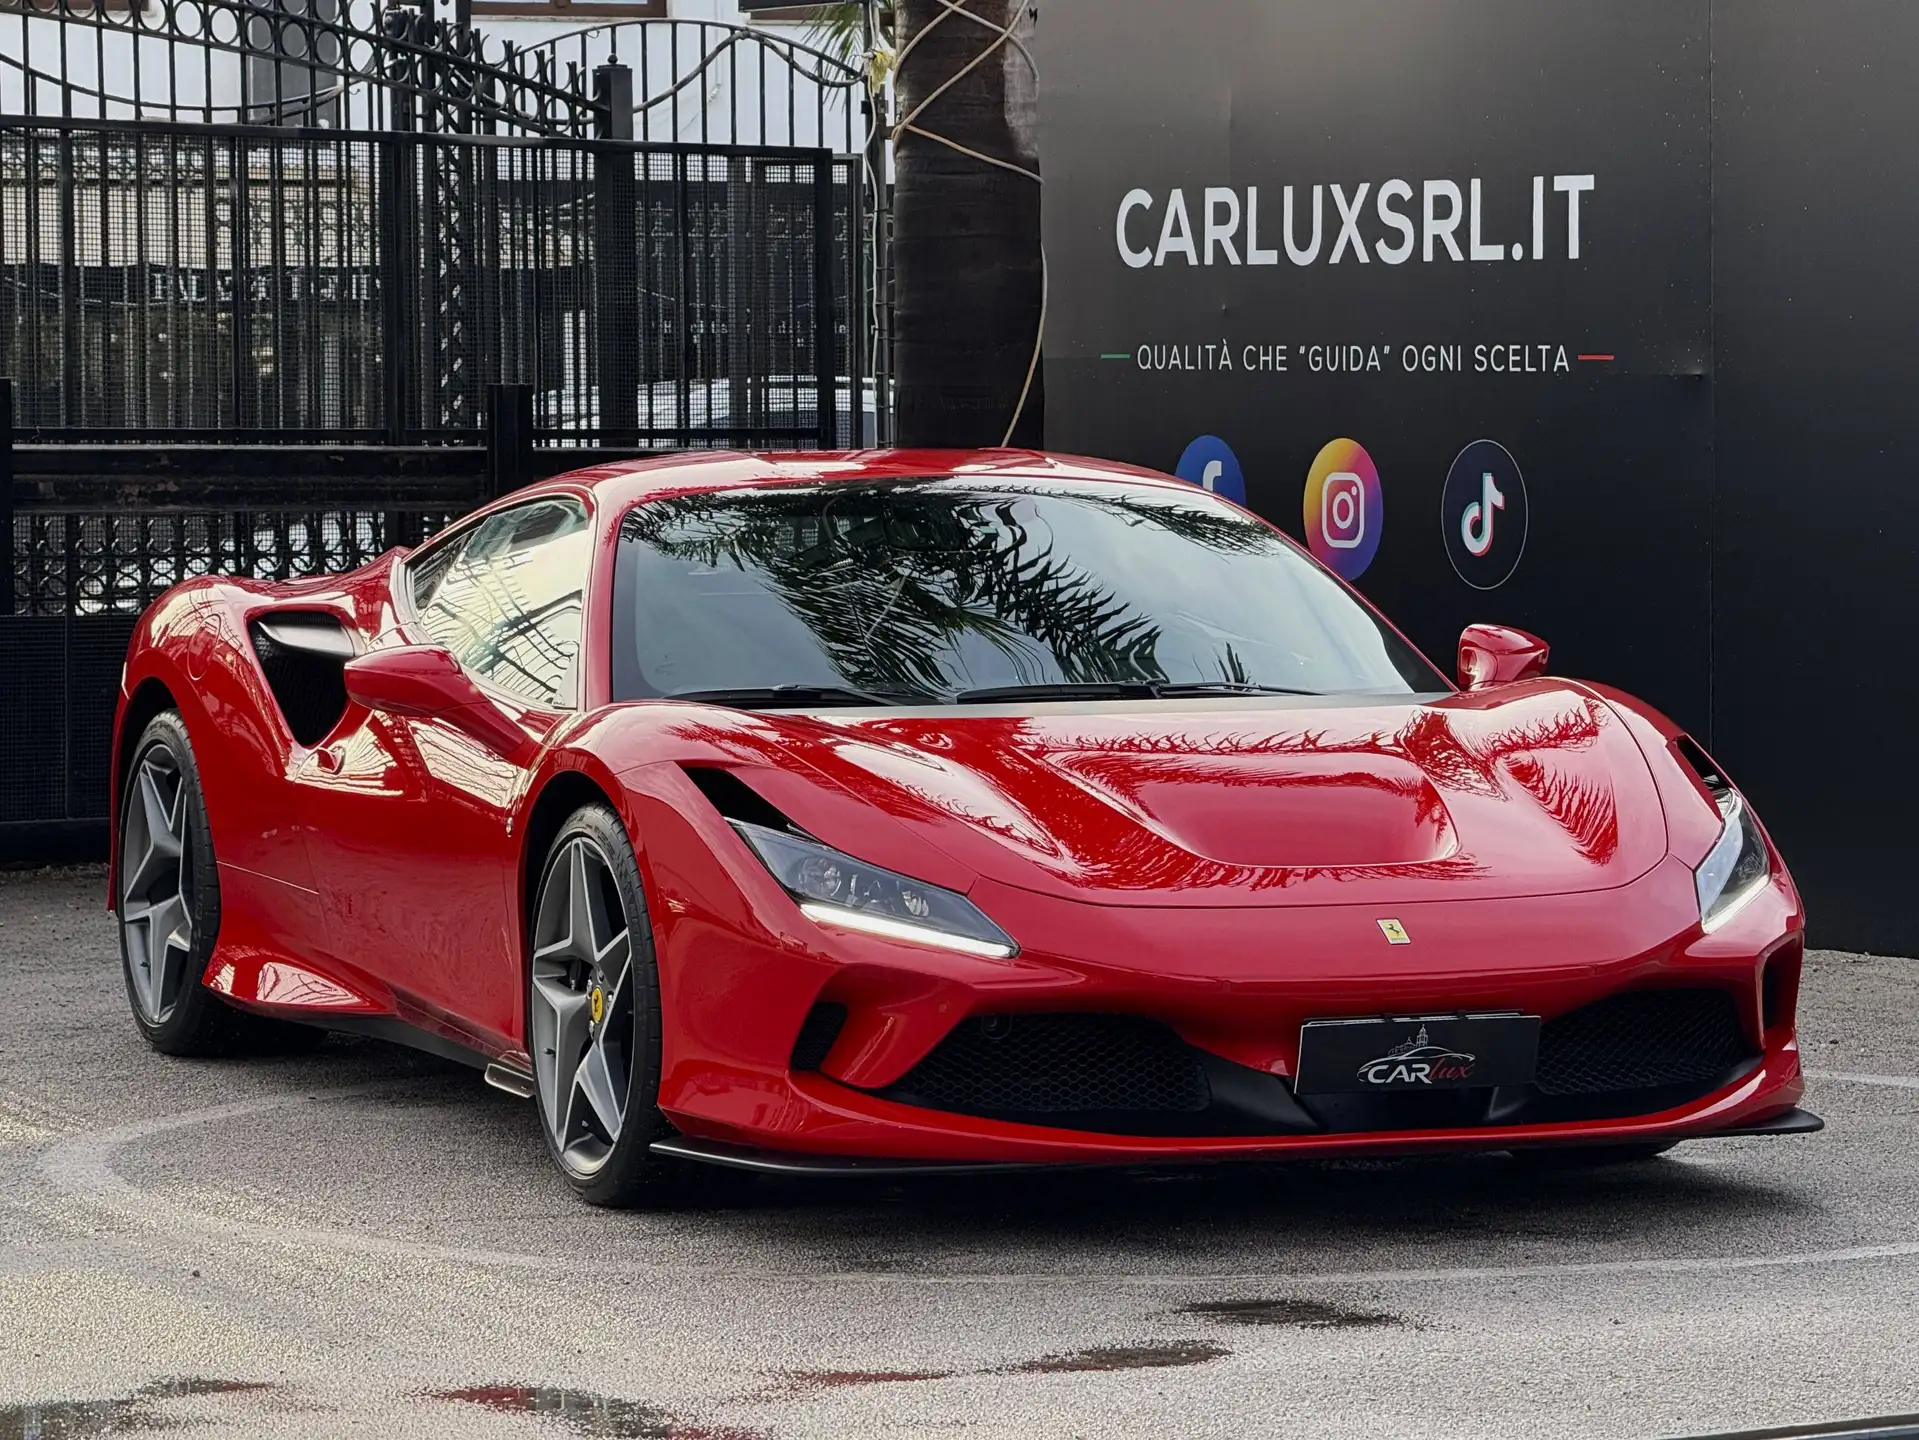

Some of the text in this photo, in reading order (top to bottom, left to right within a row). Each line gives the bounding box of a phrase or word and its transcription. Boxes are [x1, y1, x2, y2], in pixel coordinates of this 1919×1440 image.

[1116, 174, 1595, 268] CARLUXSRL.IT
[1136, 338, 1233, 371] QUALITÀ
[1243, 345, 1288, 371] CHE
[1402, 344, 1462, 372] OGNI
[1473, 344, 1570, 373] SCELTA
